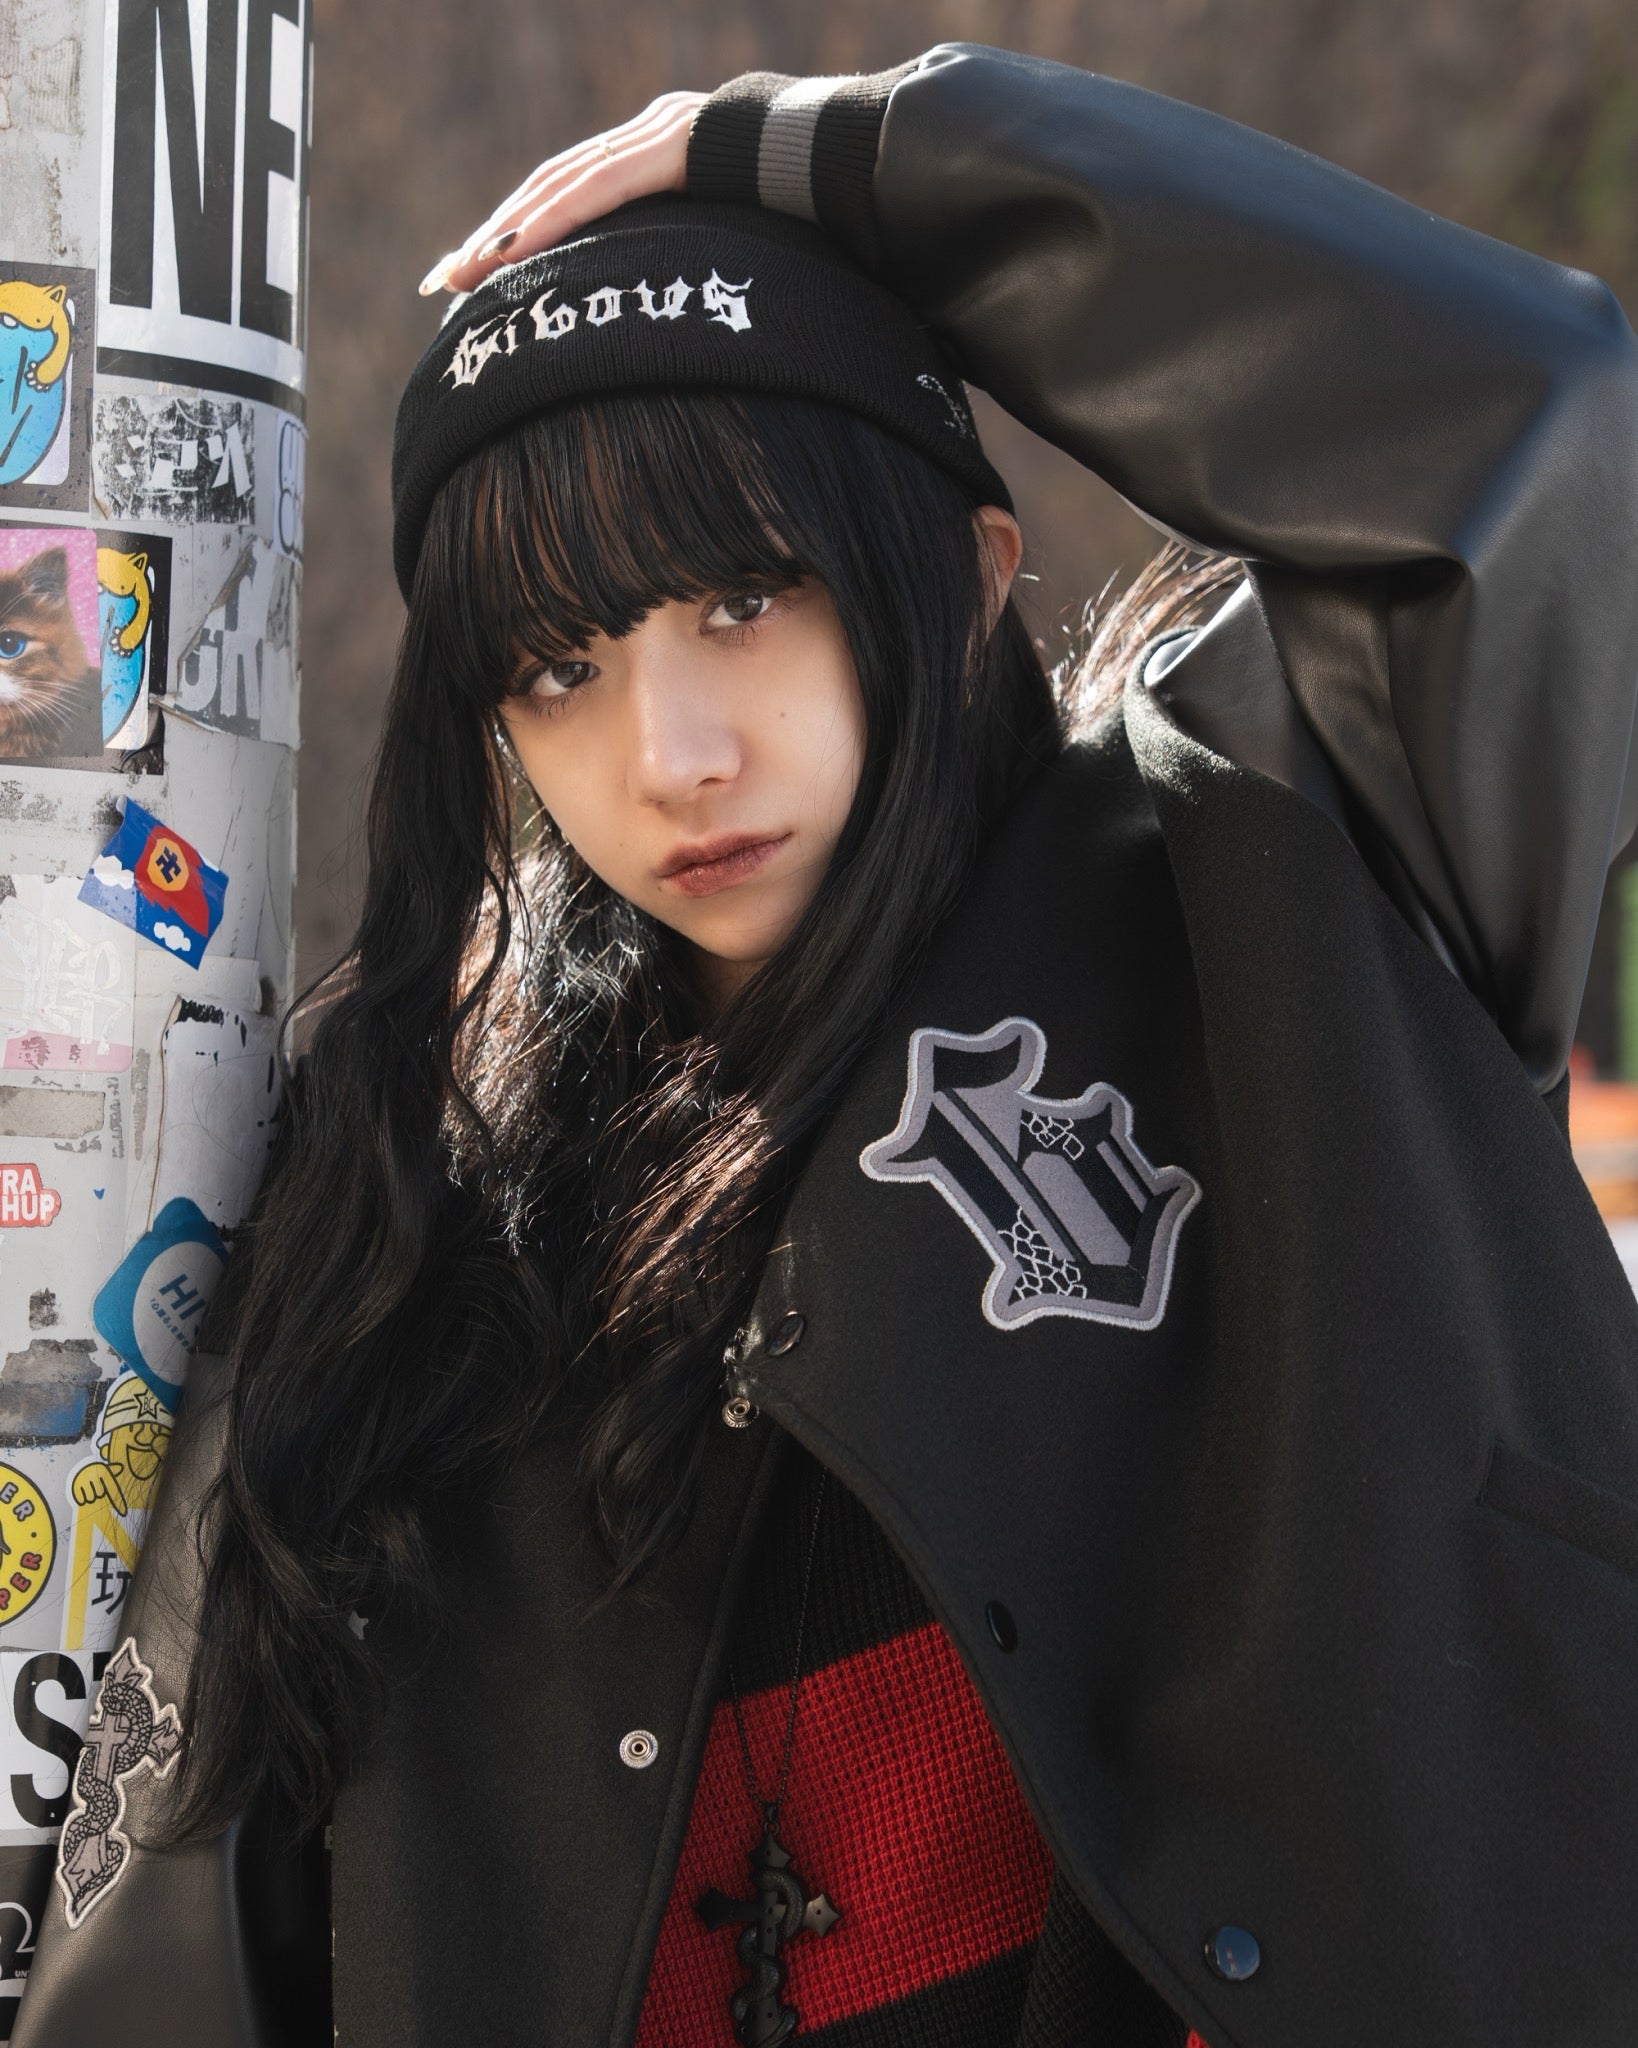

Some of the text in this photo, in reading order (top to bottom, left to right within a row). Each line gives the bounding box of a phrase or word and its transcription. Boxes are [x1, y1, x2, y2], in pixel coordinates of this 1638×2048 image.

[110, 0, 311, 349] NE
[0, 1168, 37, 1195] RA
[2, 1194, 55, 1221] HUP
[159, 1273, 207, 1338] HI
[10, 1651, 112, 1828] S
[14, 1968, 31, 1979] UN
